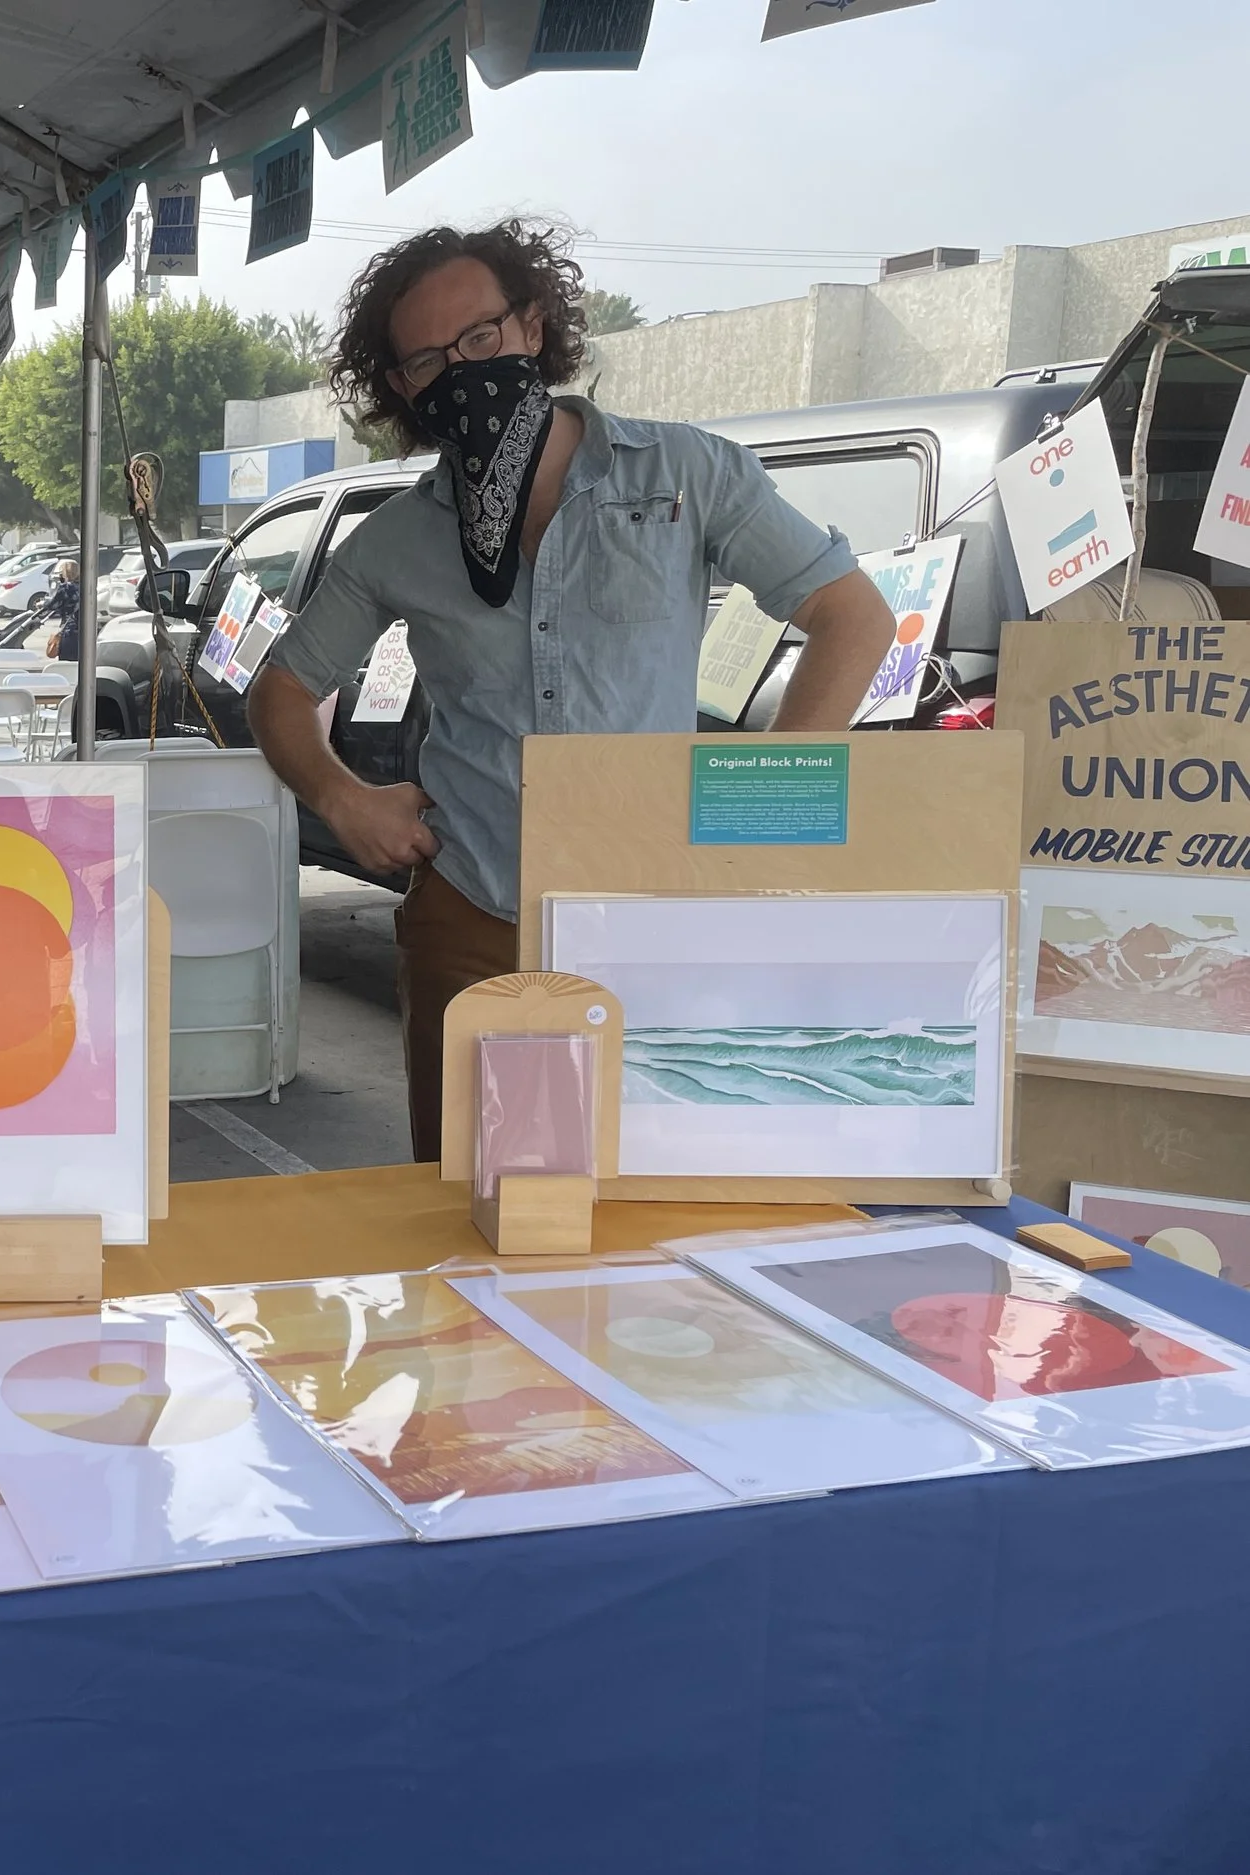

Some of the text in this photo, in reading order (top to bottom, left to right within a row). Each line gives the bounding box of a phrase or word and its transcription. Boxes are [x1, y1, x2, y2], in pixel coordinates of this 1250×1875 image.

[411, 87, 463, 139] TIMES
[414, 72, 458, 119] GOOD
[416, 111, 461, 157] ROLL
[1030, 438, 1074, 475] one
[1048, 535, 1110, 587] earth
[378, 643, 404, 665] long
[387, 631, 401, 643] as
[1128, 626, 1225, 661] THE
[377, 665, 392, 676] as
[364, 681, 391, 699] you
[369, 695, 400, 709] want
[708, 757, 832, 769] Original Block Prints!
[1029, 827, 1172, 864] MOBILE
